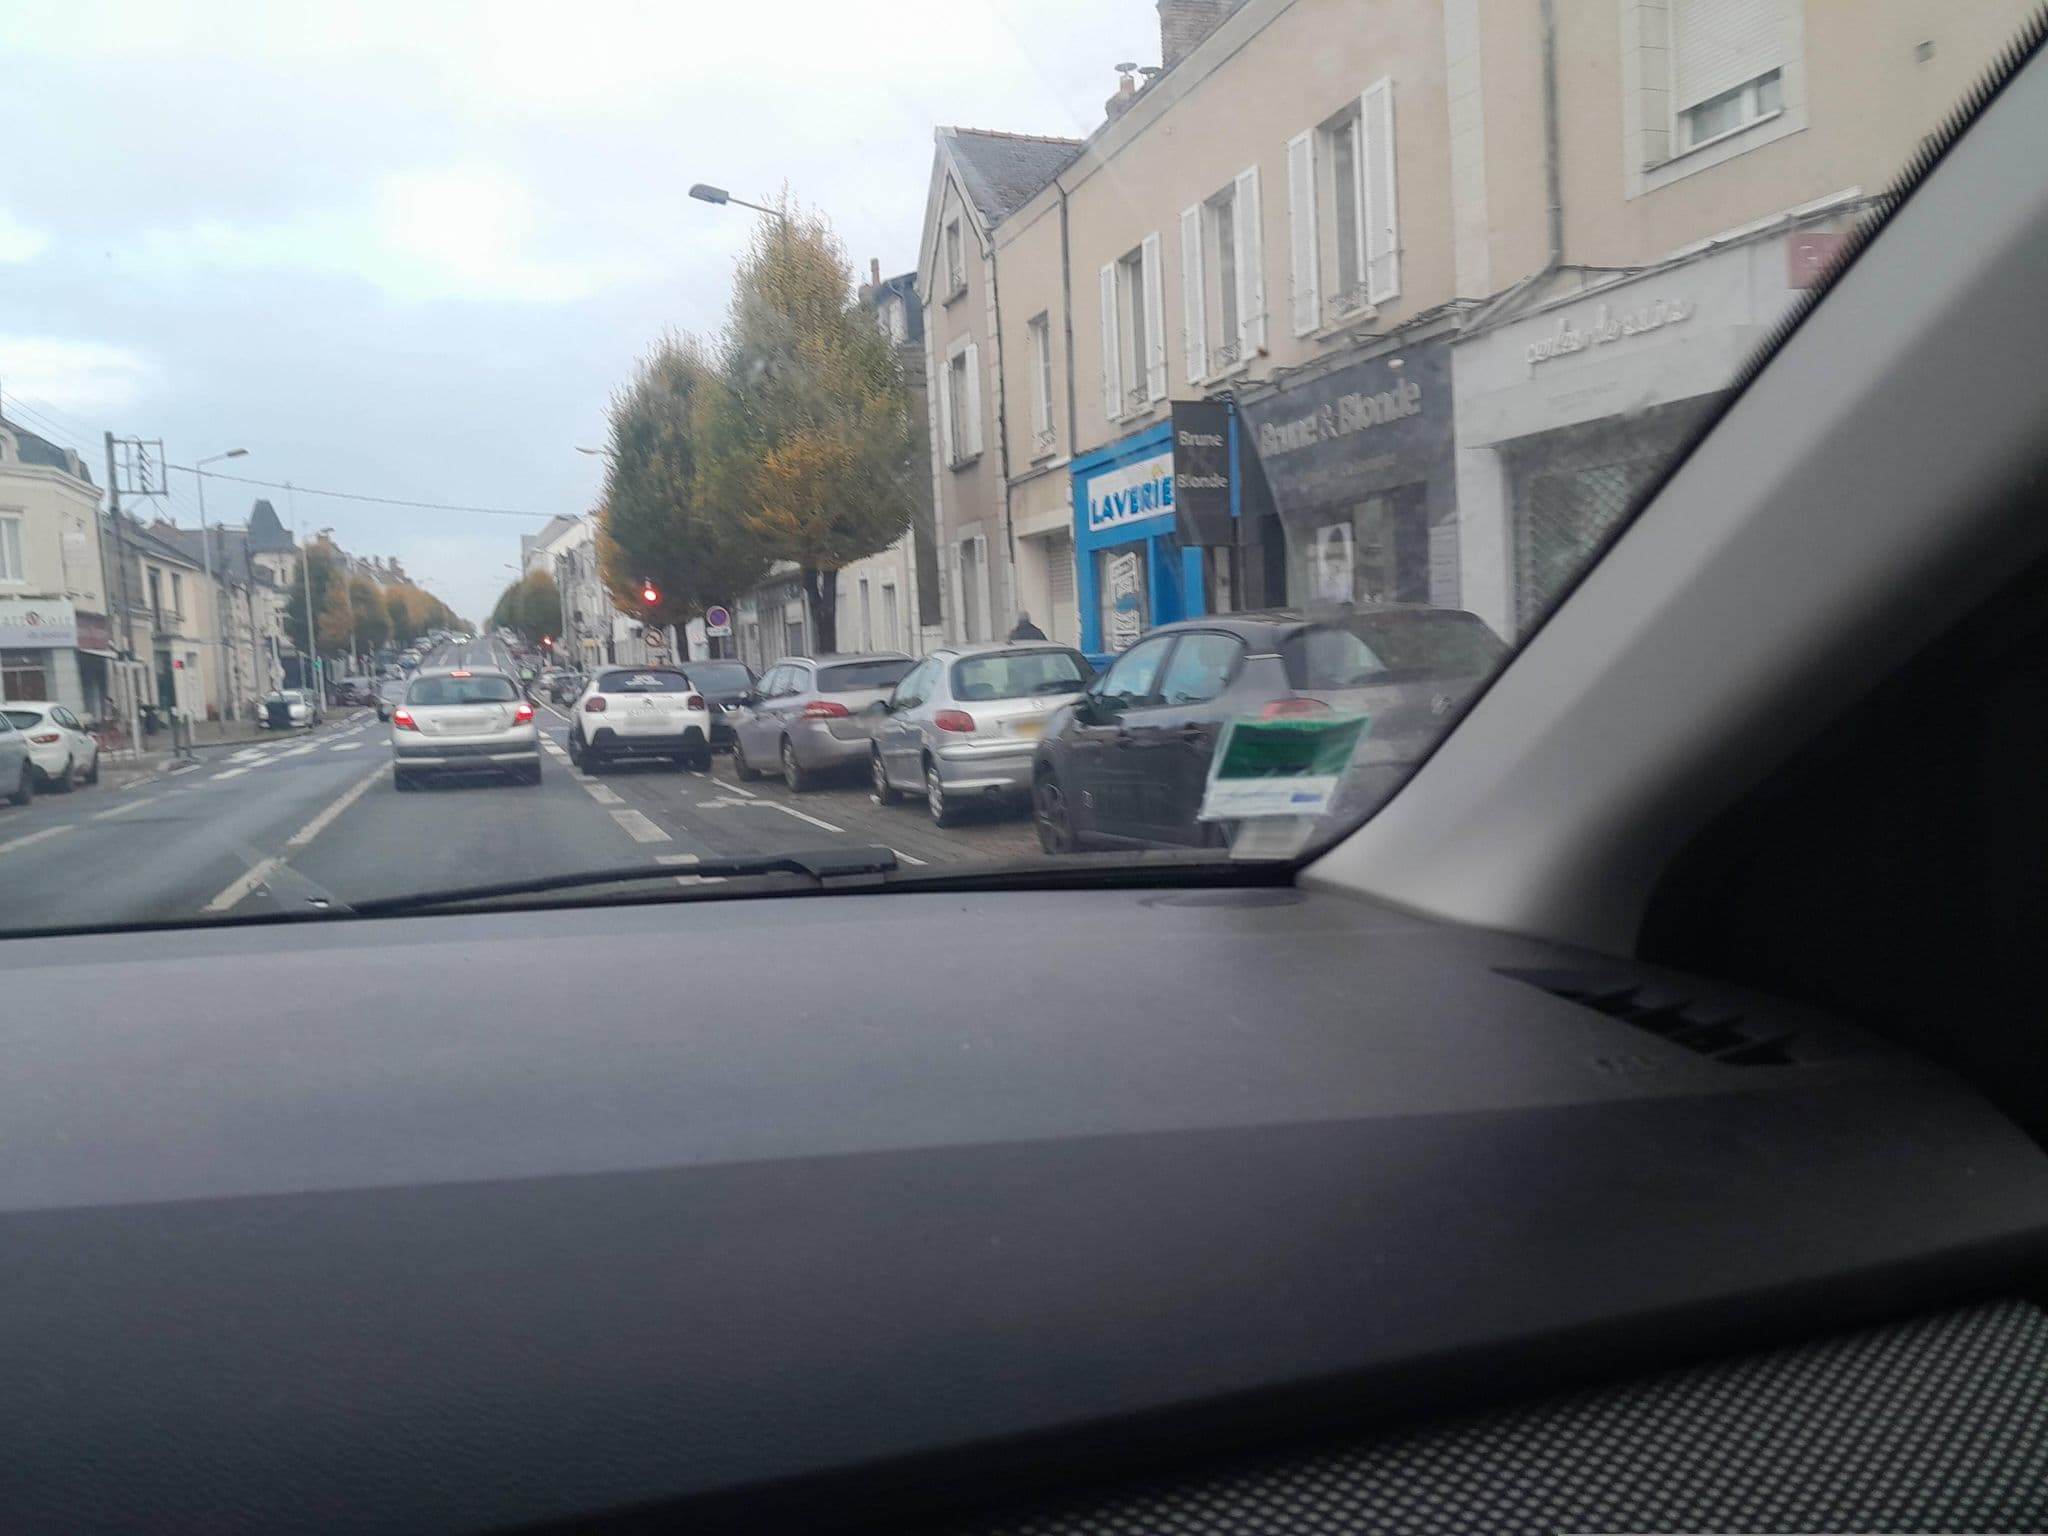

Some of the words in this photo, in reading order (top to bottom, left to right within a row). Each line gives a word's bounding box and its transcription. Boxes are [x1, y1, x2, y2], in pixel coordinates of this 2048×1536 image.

[1261, 415, 1318, 458] Brune
[1317, 403, 1339, 442] &
[1338, 377, 1423, 435] Blonde
[1177, 430, 1224, 448] Brune
[1176, 472, 1229, 489] Blonde
[1091, 475, 1174, 526] LAVERIE
